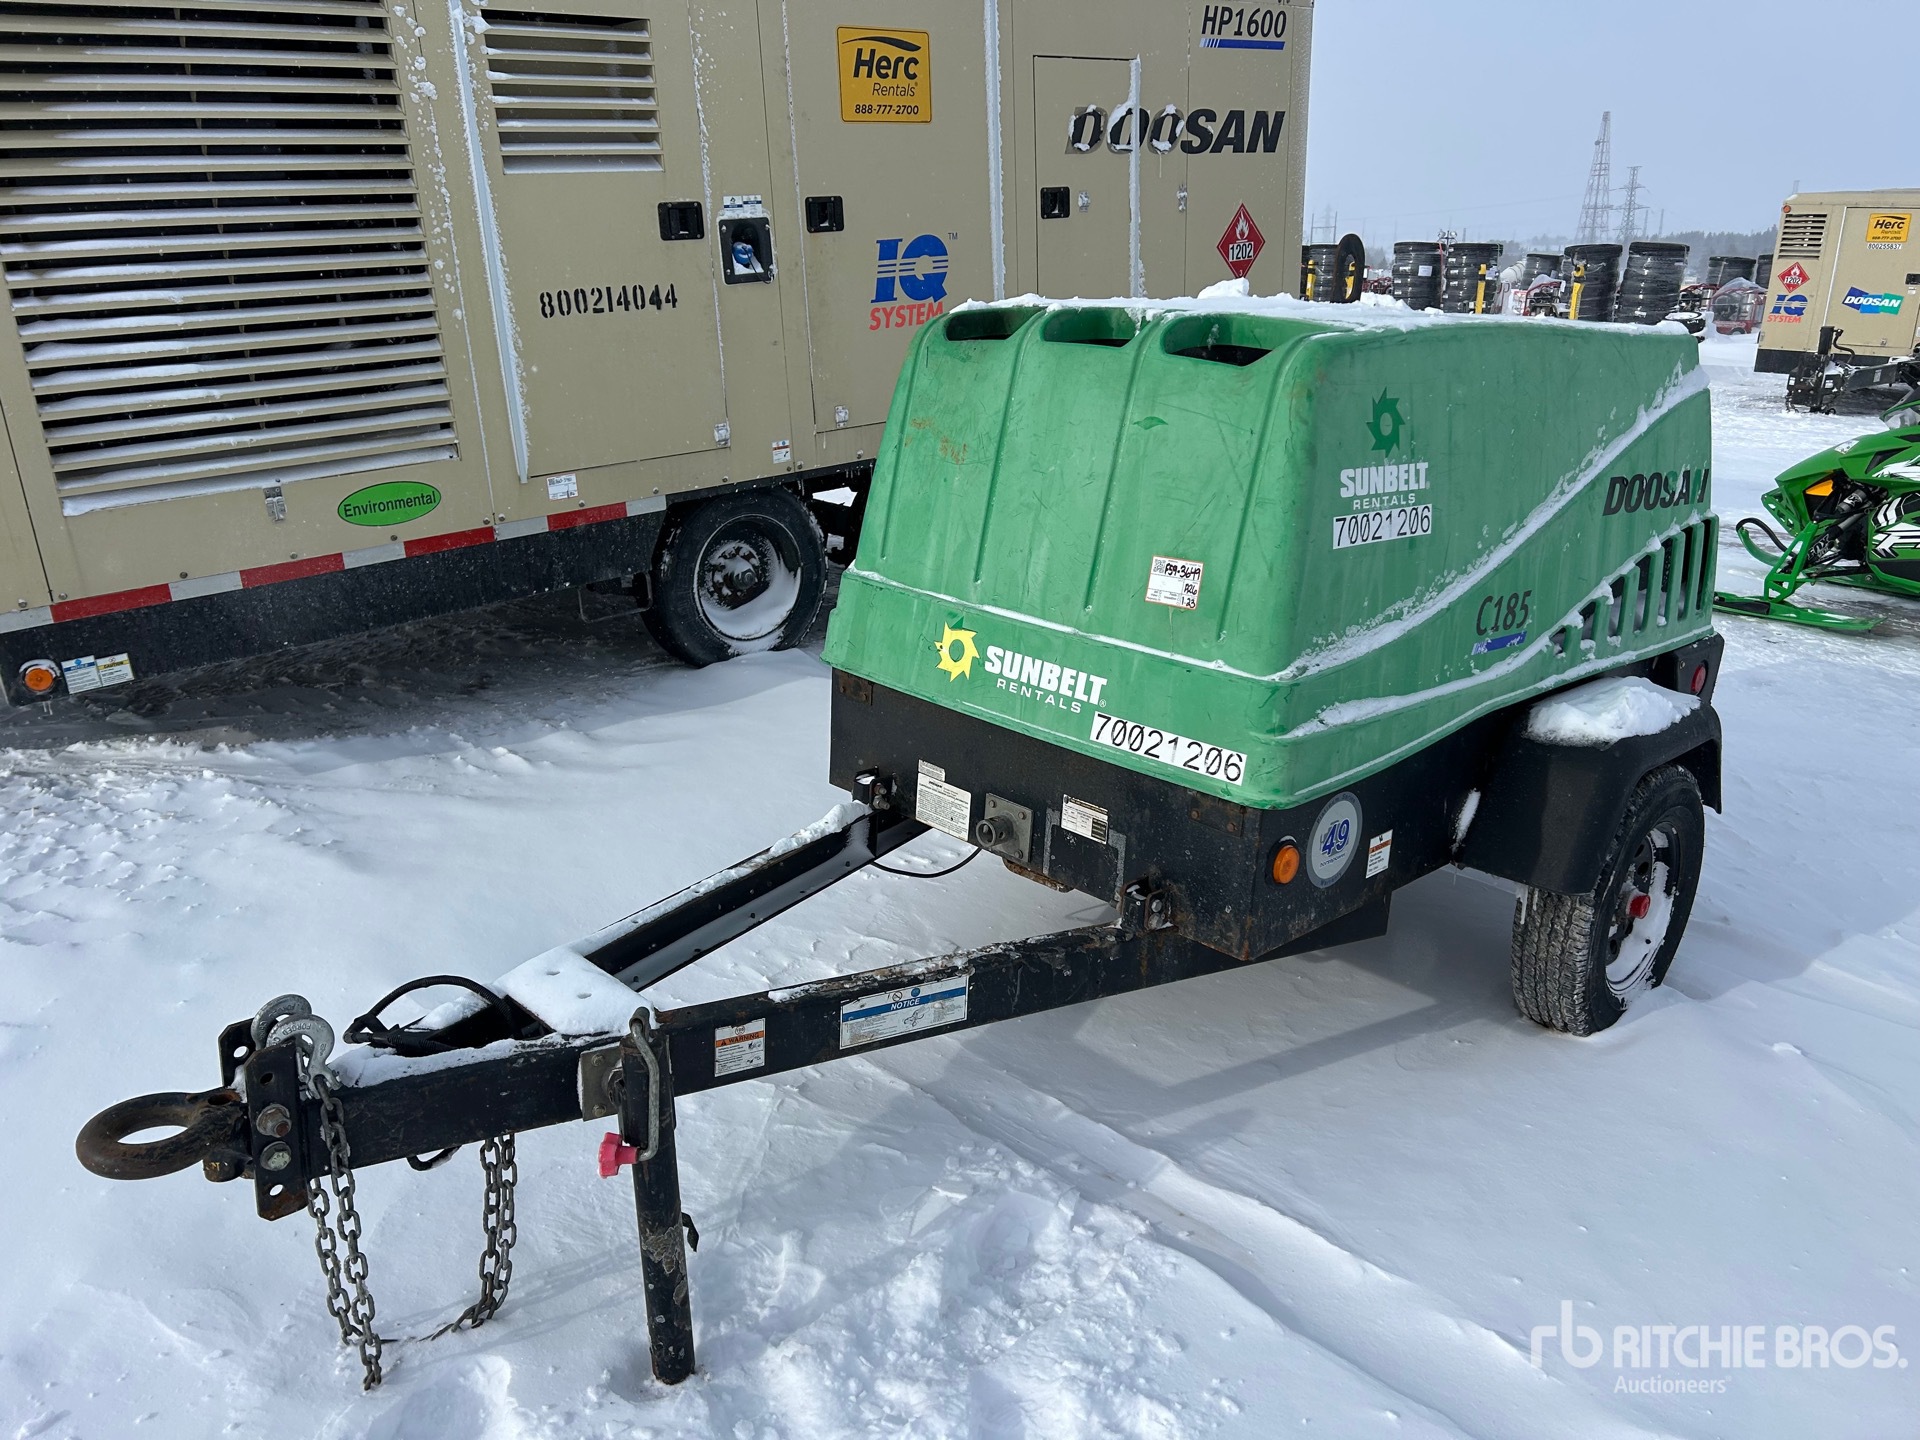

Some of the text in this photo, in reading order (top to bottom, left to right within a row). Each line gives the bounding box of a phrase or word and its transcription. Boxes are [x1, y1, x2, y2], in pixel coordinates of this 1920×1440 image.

[1201, 5, 1287, 39] HP1600
[853, 48, 919, 80] Herc
[872, 82, 916, 97] Rentals
[854, 104, 919, 115] 888-777-2700
[1068, 104, 1285, 155] DOOSAN
[1873, 219, 1905, 229] Herc
[1230, 242, 1253, 260] 1202
[871, 233, 948, 304] IQ
[540, 284, 678, 319] 800214044
[869, 301, 944, 331] SYSTEM
[1770, 294, 1809, 316] IQ
[1844, 296, 1902, 307] DOOSAN
[1767, 315, 1802, 323] SYSTEM
[1340, 462, 1428, 498] SUNBELT
[343, 490, 438, 519] Environmental
[1353, 493, 1416, 510] RENTALS
[1335, 514, 1431, 547] 70021206
[1476, 590, 1532, 636] C185
[985, 646, 1107, 705] SUNBELT
[997, 679, 1082, 714] RENTALS
[1096, 713, 1244, 782] 70021206
[1321, 818, 1351, 856] 49
[890, 998, 921, 1011] NOTICE
[729, 1033, 760, 1043] WARNING
